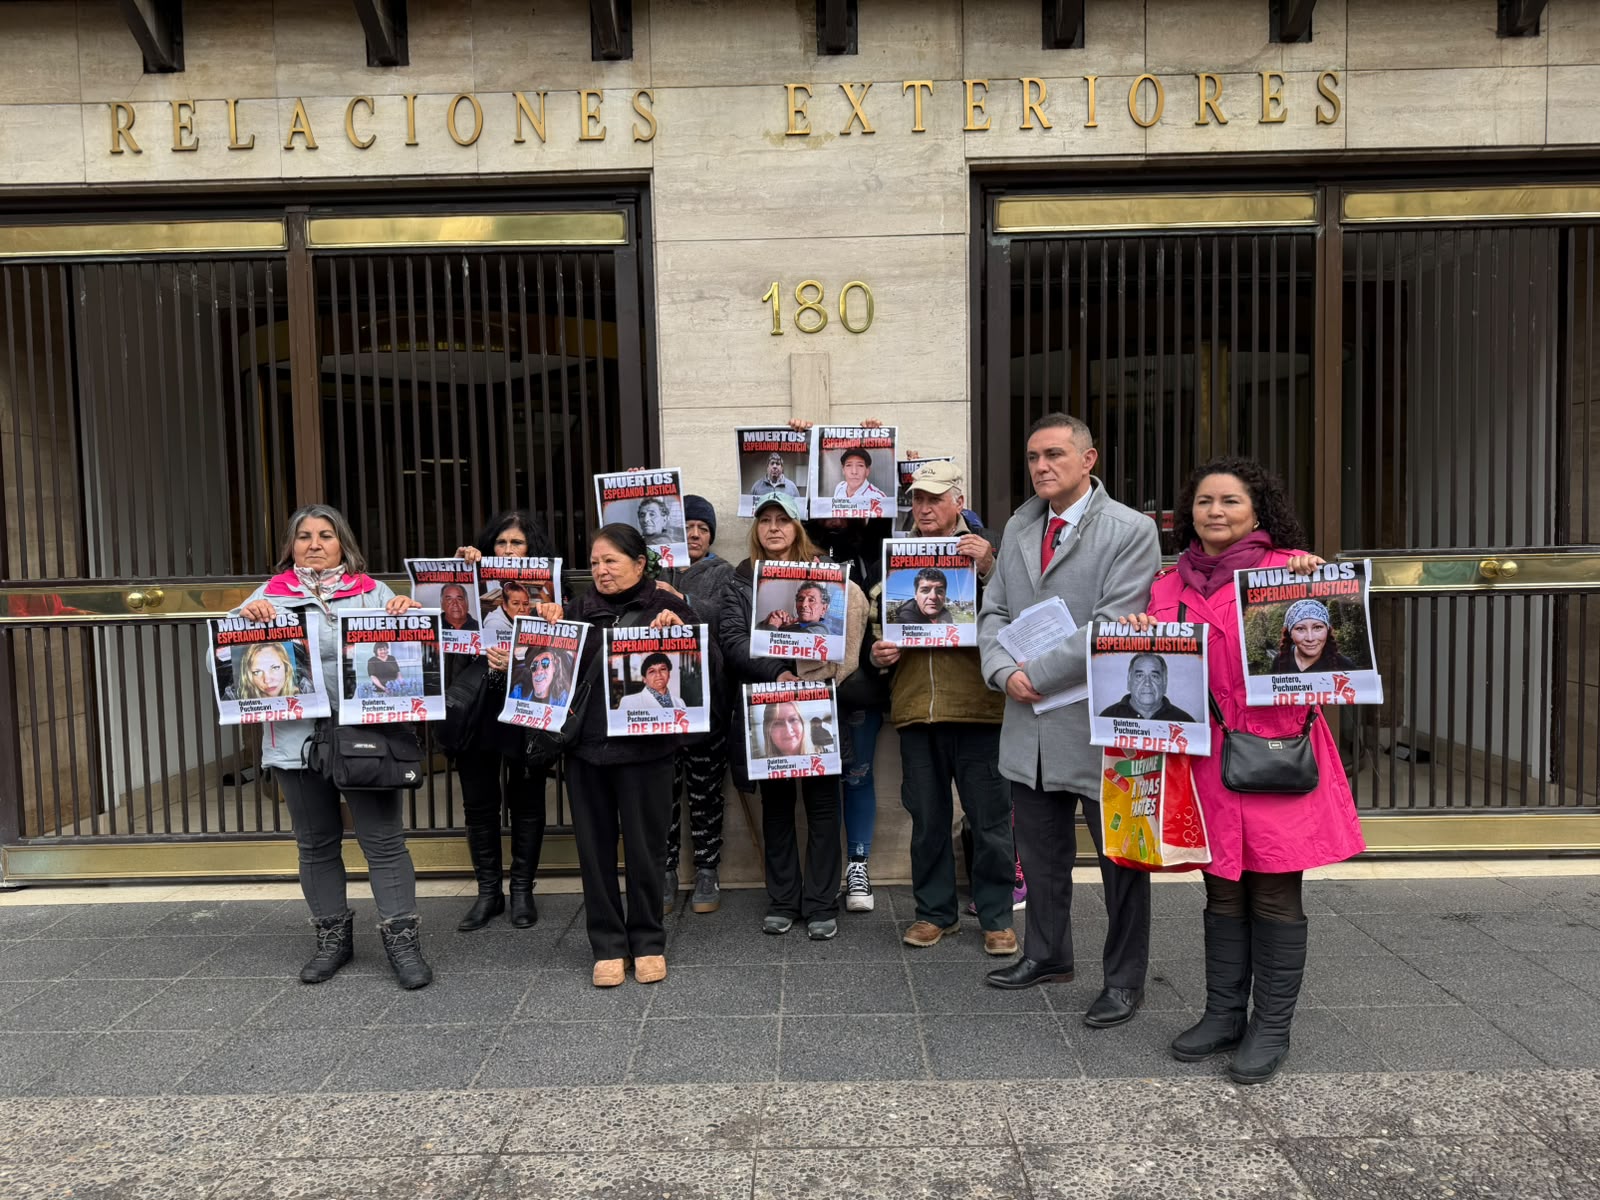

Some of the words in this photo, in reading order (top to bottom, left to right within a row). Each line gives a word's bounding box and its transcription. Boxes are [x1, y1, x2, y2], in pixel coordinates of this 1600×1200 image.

[108, 88, 658, 154] RELACIONES
[783, 70, 1342, 136] EXTERIORES
[762, 279, 875, 336] 180
[743, 431, 806, 442] MUERTOS
[824, 428, 890, 438] MUERTOS
[743, 442, 779, 452] ESPERANDO
[779, 442, 807, 453] JUSTICIA
[822, 438, 861, 449] ESPERANDO
[862, 438, 892, 448] JUSTICIA
[603, 472, 673, 489] MUERTOS
[603, 486, 645, 500] ESPERANDO
[645, 484, 677, 496] JUSTICIA
[892, 543, 960, 556] MUERTO
[413, 560, 473, 572] MUERTO
[480, 556, 549, 569] MUERTOS
[890, 555, 935, 567] ESPERANDO
[936, 555, 971, 567] JUSTICIA
[416, 571, 453, 583] ESPERANDO
[454, 571, 474, 583] JUST
[480, 568, 519, 579] ESPERANDO
[519, 568, 550, 580] JUSTICIA
[762, 566, 807, 579] ESPERANDO
[808, 568, 843, 581] JUSTICIA
[1247, 583, 1308, 603] ESPERANDO
[1308, 579, 1360, 598] JUSTICIA
[347, 616, 432, 631] MUERTOS
[520, 620, 579, 638] MUERTOS
[216, 629, 266, 645] ESPERANDO
[266, 626, 304, 640] JUSTICIA
[346, 630, 396, 643] ESPERANDO
[397, 629, 435, 641] JUSTICIA
[613, 625, 694, 640] MUERTOS
[518, 633, 551, 647] ESPERANDO
[551, 636, 579, 650] JUSTICIA
[611, 640, 659, 653] ESPERANDO
[660, 638, 697, 650] JUSTICIA
[1096, 636, 1151, 651] ESPERANDO
[1152, 636, 1198, 652] JUSTICIA
[751, 691, 795, 704] ESPERANDO
[795, 688, 830, 700] JUSTICIA
